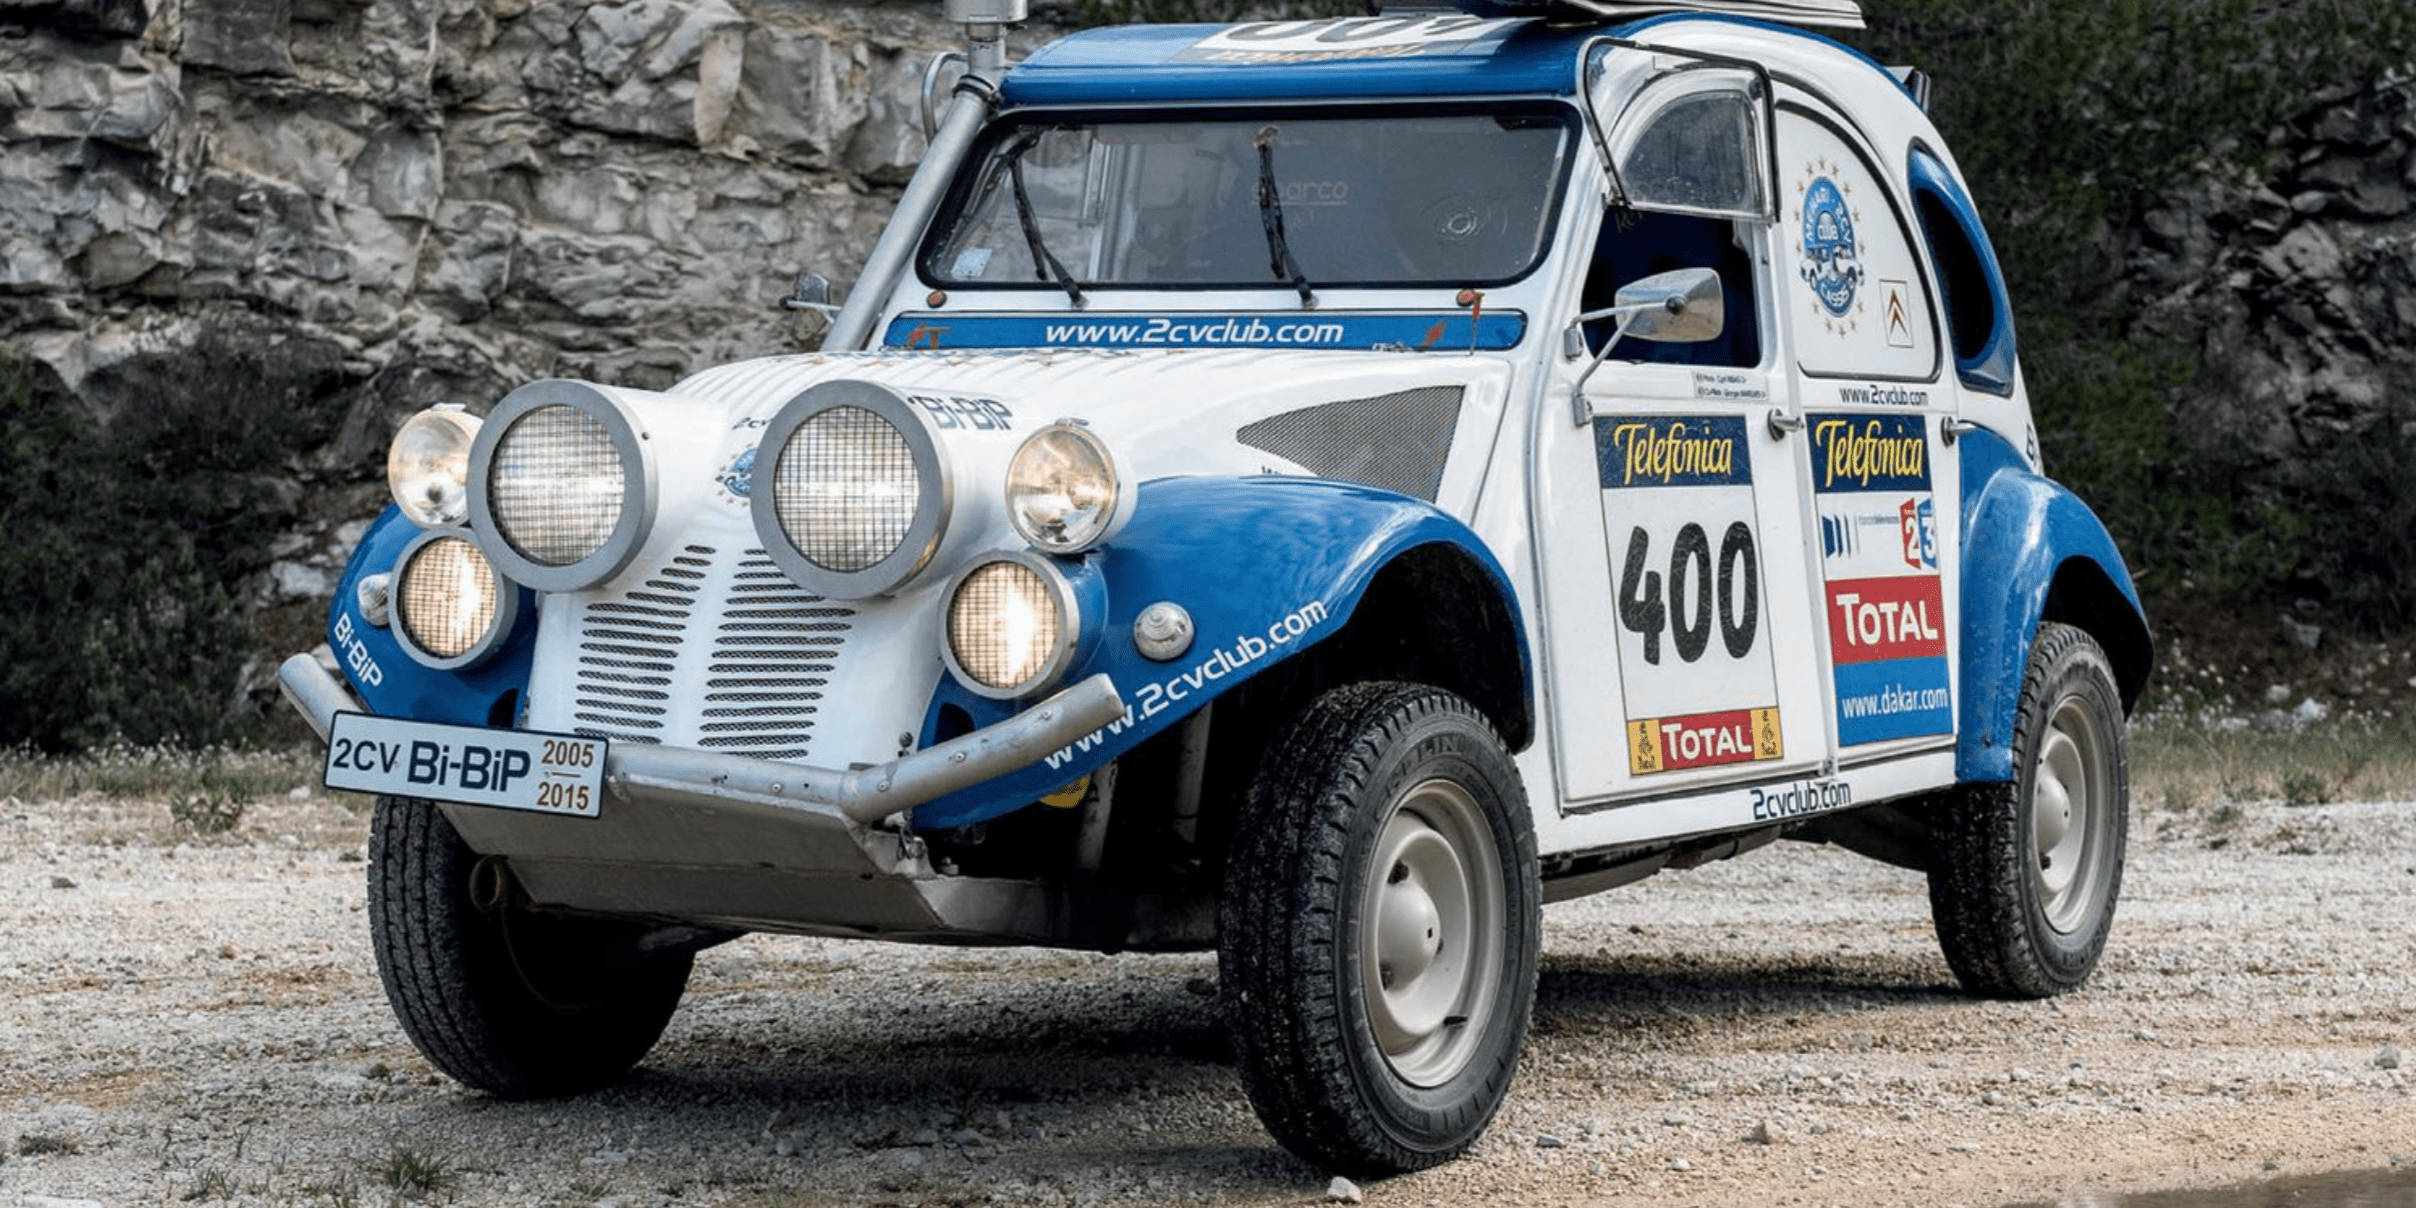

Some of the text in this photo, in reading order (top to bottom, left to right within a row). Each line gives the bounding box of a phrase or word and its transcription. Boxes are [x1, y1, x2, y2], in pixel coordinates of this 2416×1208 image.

[1046, 318, 1344, 343] www.2cvclub.com
[1839, 384, 1929, 406] www.2cvclub.com
[1618, 520, 1759, 666] 400
[1835, 593, 1939, 646] TOTAL
[333, 612, 384, 687] Bi-BiP
[1841, 683, 1949, 719] www.dakar.com
[541, 739, 595, 768] 2005
[1661, 723, 1753, 761] TOTAL
[332, 738, 531, 792] 2CV Bi-BiP
[536, 781, 590, 810] 2015
[1750, 781, 1852, 820] 2cvclub.com
